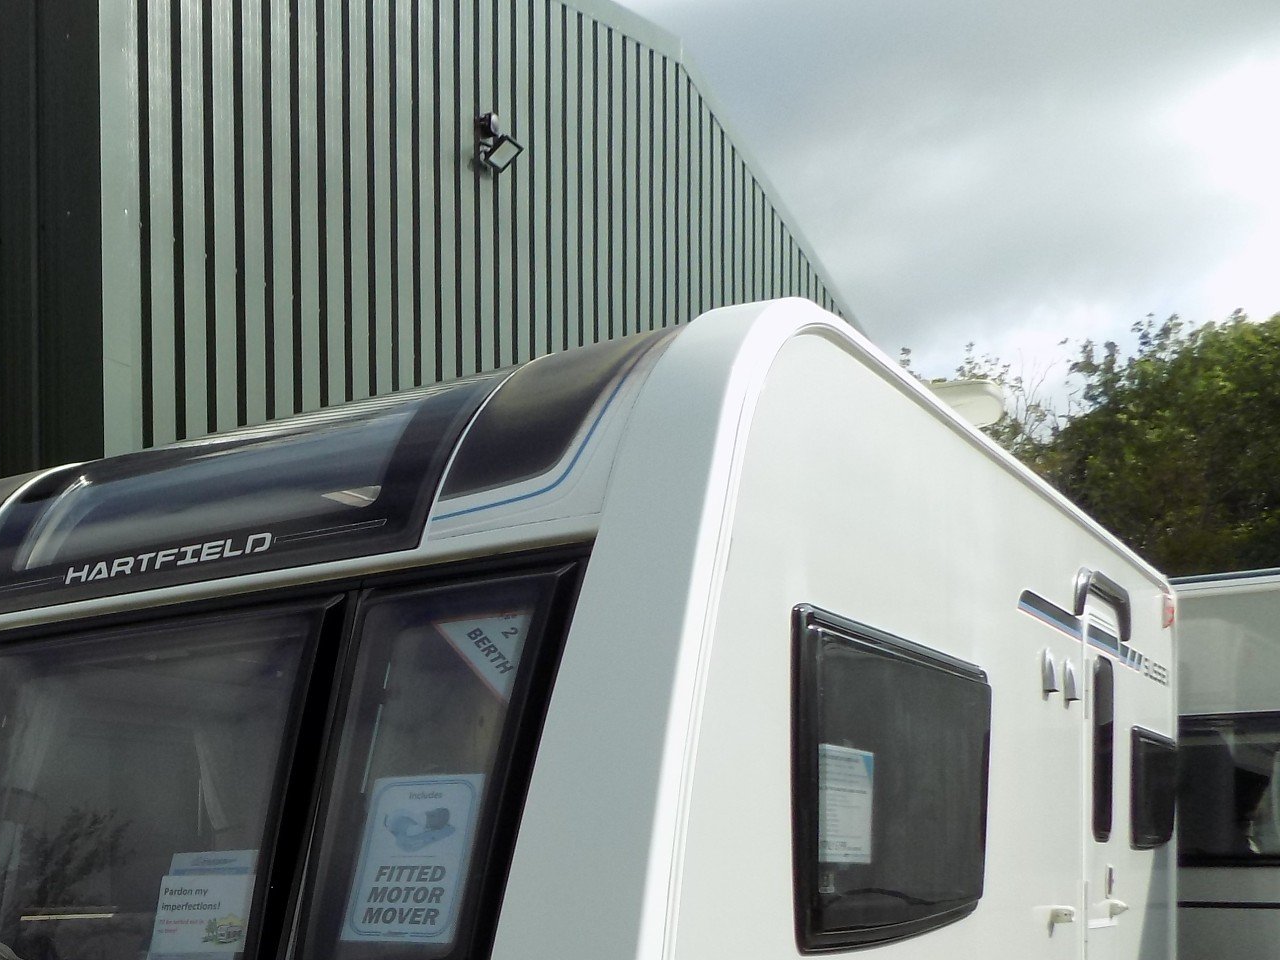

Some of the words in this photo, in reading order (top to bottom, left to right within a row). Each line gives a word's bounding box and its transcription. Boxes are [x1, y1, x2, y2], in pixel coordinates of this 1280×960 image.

[64, 532, 272, 584] HARTFIELD
[501, 626, 518, 639] 2
[466, 627, 514, 674] BERTH
[408, 791, 443, 800] Includes
[374, 865, 447, 883] FITTED
[164, 887, 192, 896] Pardon
[195, 888, 208, 897] my
[367, 886, 445, 904] MOTOR
[161, 902, 221, 912] imperfections!
[361, 907, 440, 926] MOVER
